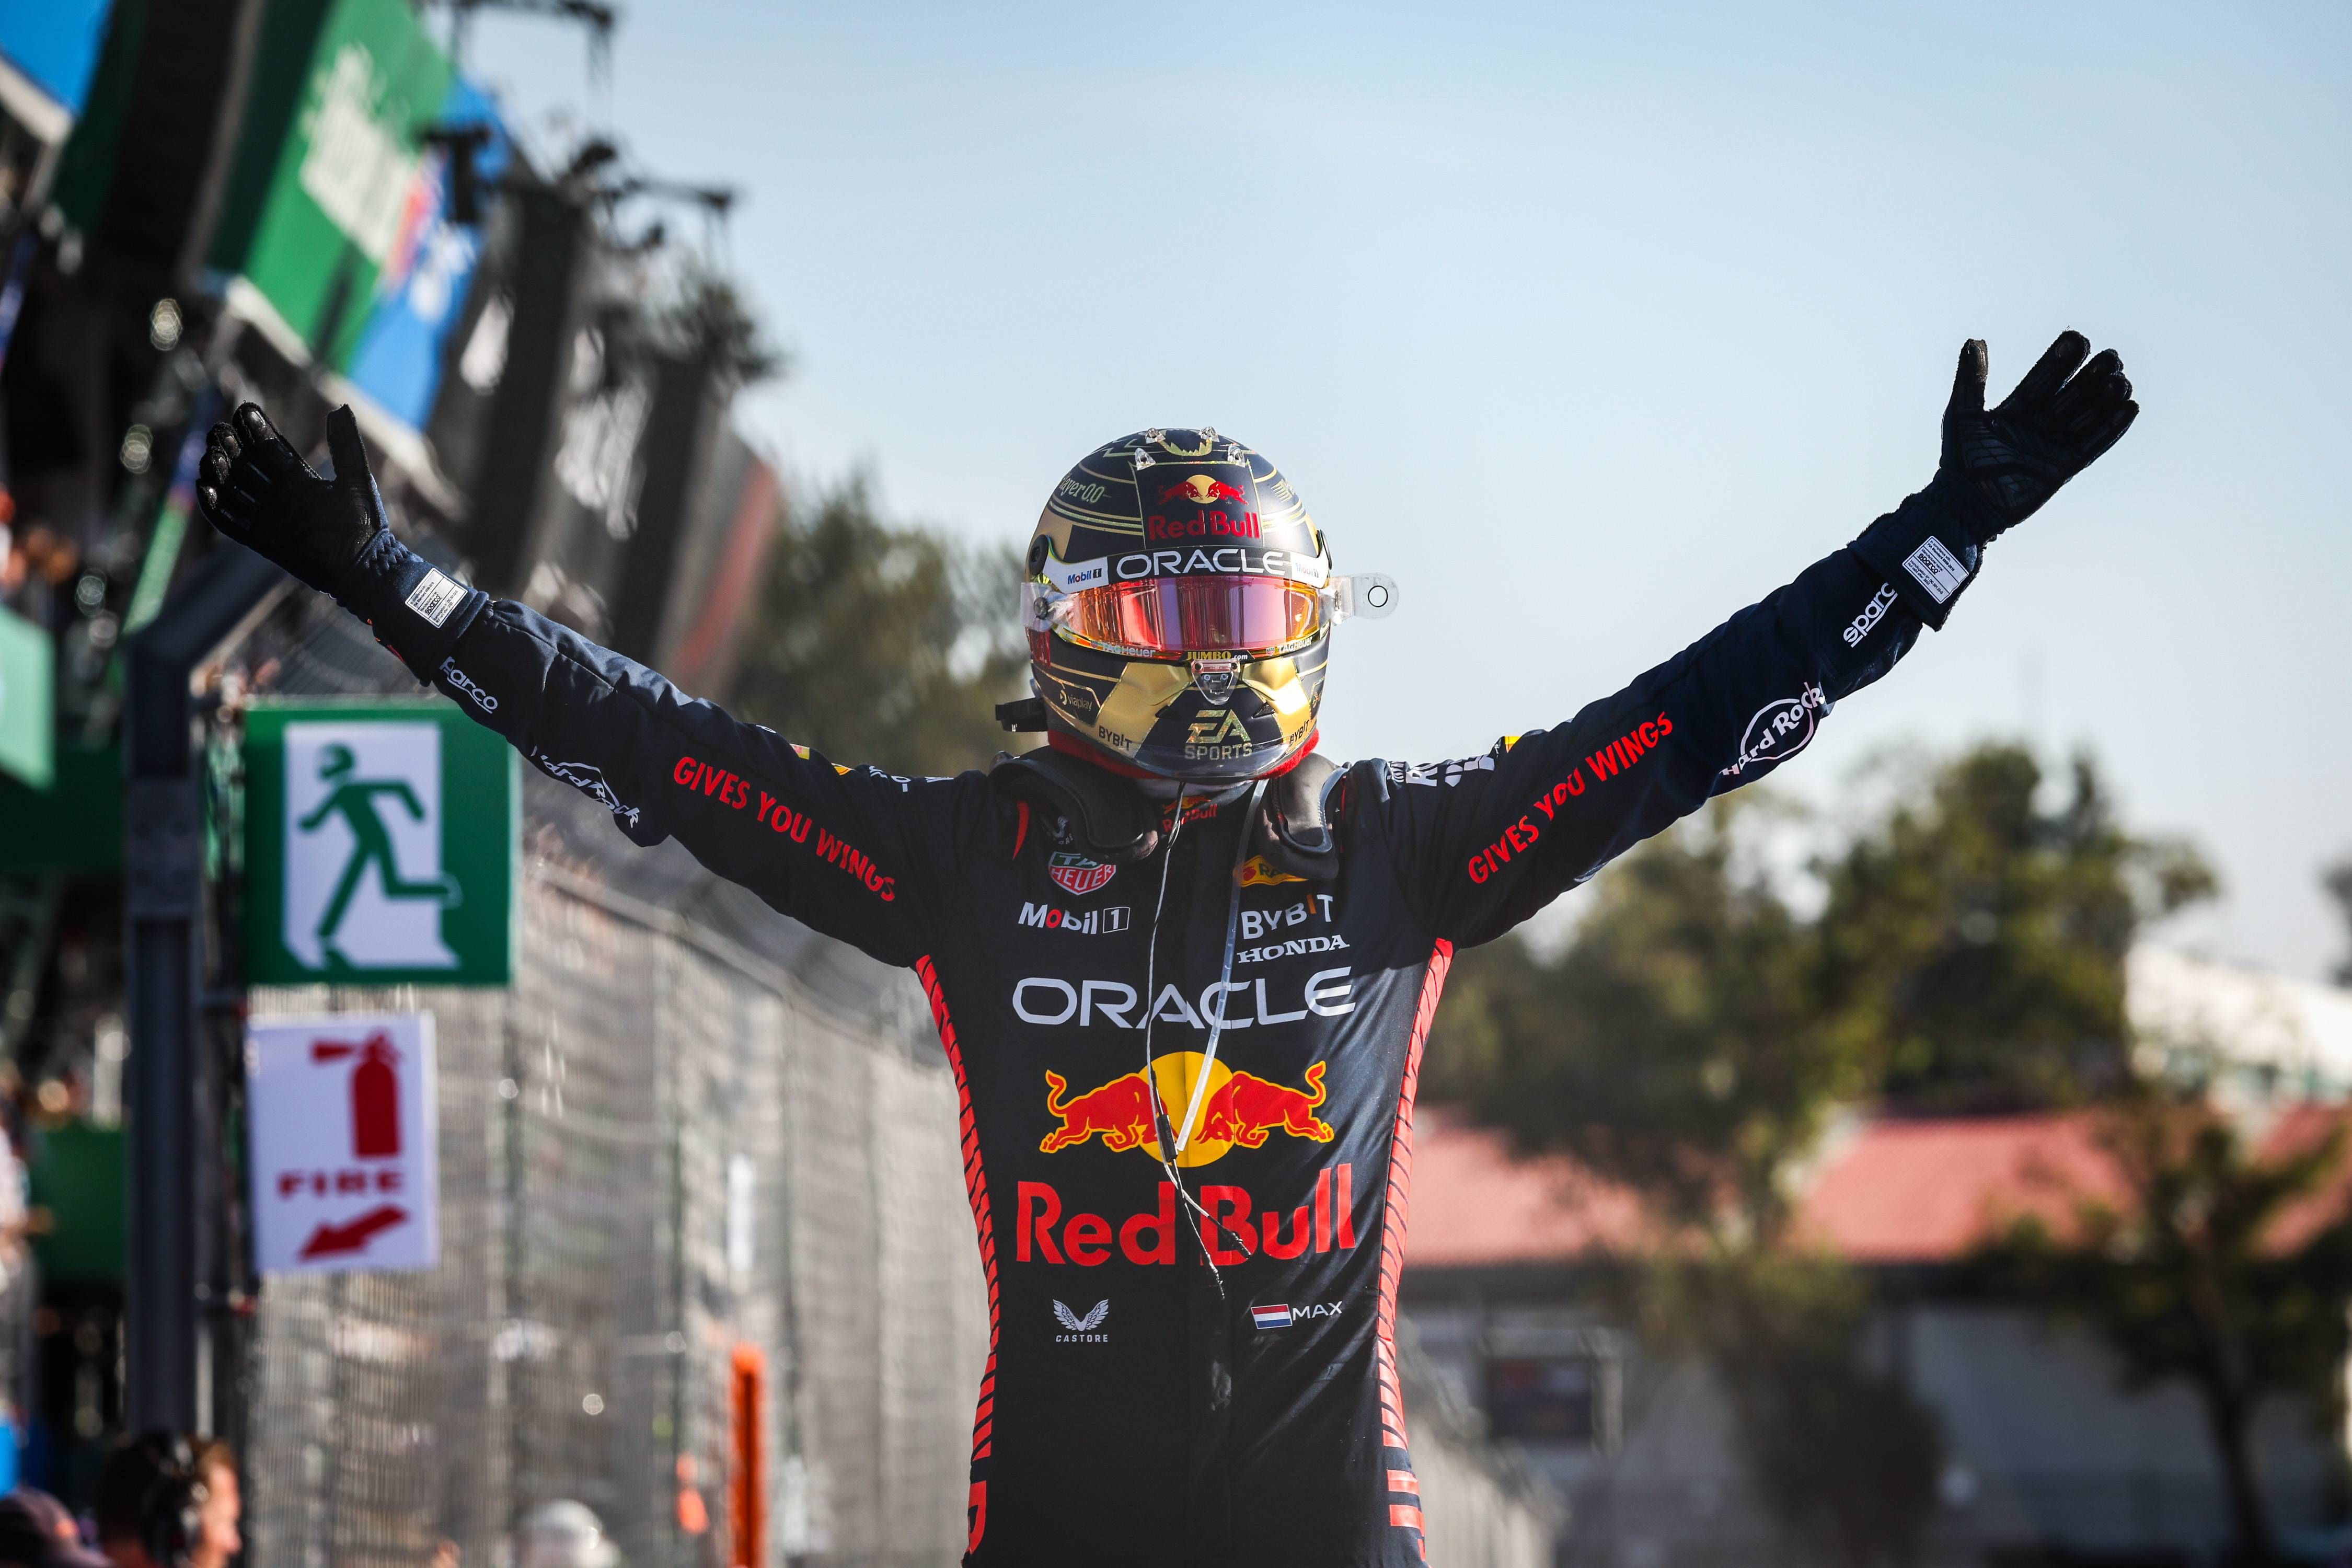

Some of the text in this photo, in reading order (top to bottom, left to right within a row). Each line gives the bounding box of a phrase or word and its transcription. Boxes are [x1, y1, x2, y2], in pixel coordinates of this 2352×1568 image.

[1148, 510, 1261, 540] Red Bull
[1068, 570, 1091, 585] Mobil
[1116, 549, 1286, 579] ORACLE
[1843, 582, 1898, 648] sparc
[439, 656, 498, 714] parco
[1068, 694, 1092, 711] viaplay
[1098, 725, 1133, 751] BYBIT
[1186, 709, 1251, 744] EA
[1184, 742, 1253, 760] SPORTS
[1719, 728, 1776, 776] Hard
[1468, 814, 1539, 884] GIVES
[1533, 767, 1586, 822] YOU
[1584, 711, 1673, 782] WINGS
[673, 756, 895, 902] GIVES YOU WINGS
[1059, 855, 1098, 867] TA
[1051, 864, 1112, 891] HEUER
[1018, 901, 1098, 935] Mobil
[1240, 893, 1333, 940] BYBIT
[1236, 934, 1351, 964] HONDA
[1012, 966, 1356, 1030] ORACLE
[277, 1169, 404, 1198] FIRE
[1016, 1162, 1356, 1267] Red Bull
[1292, 1300, 1343, 1321] MAX
[1055, 1334, 1109, 1343] CASTORE
